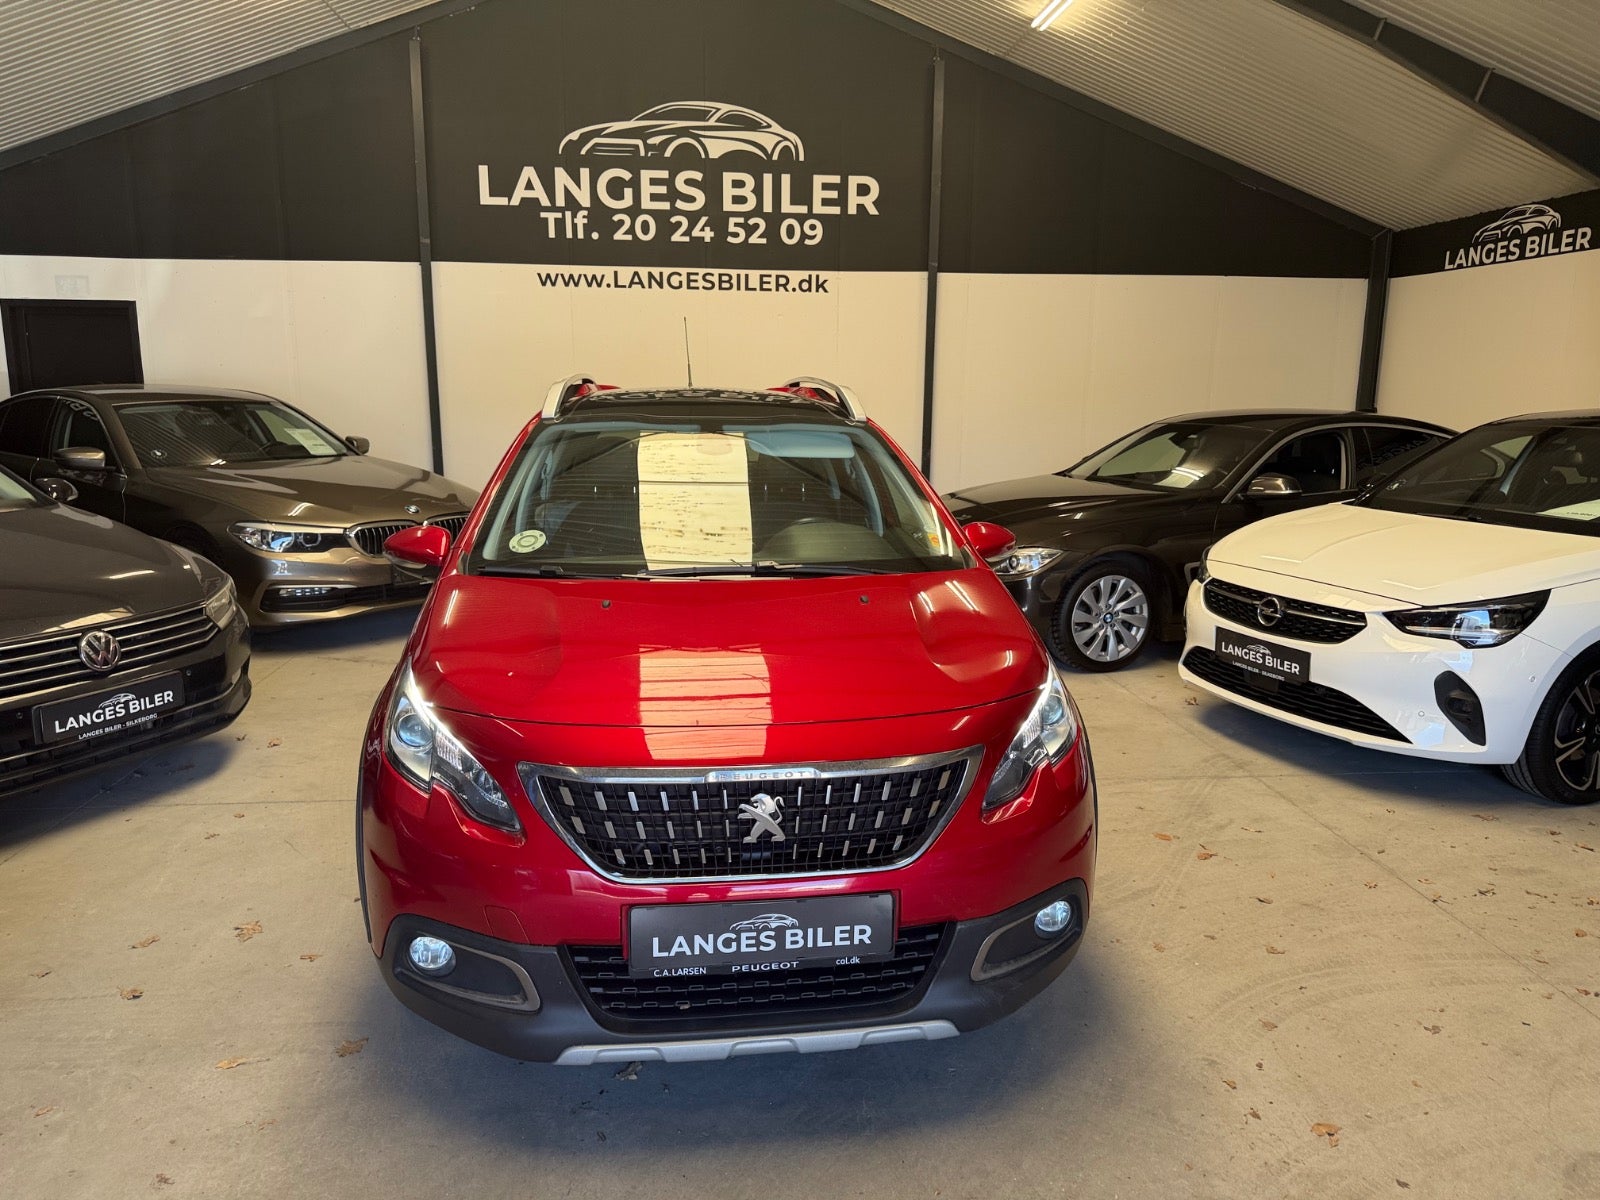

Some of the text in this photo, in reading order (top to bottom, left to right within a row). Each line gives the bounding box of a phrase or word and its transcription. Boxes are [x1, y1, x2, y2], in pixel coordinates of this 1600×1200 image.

[478, 165, 880, 216] LANGES BILER
[540, 211, 824, 246] Tlf. 20 24 52 09
[1444, 227, 1592, 270] LANGES BILER
[537, 270, 829, 293] www.LANGESBILER.dk
[1221, 641, 1300, 675] LANGES BILER
[54, 690, 174, 733] LANGES BILER
[78, 728, 104, 740] LANGES
[104, 723, 122, 733] BILER
[125, 713, 158, 727] SILKEBORG
[720, 770, 806, 780] PEUGEOT
[652, 924, 872, 958] LANGES BILER
[731, 961, 800, 973] PEUGEOT
